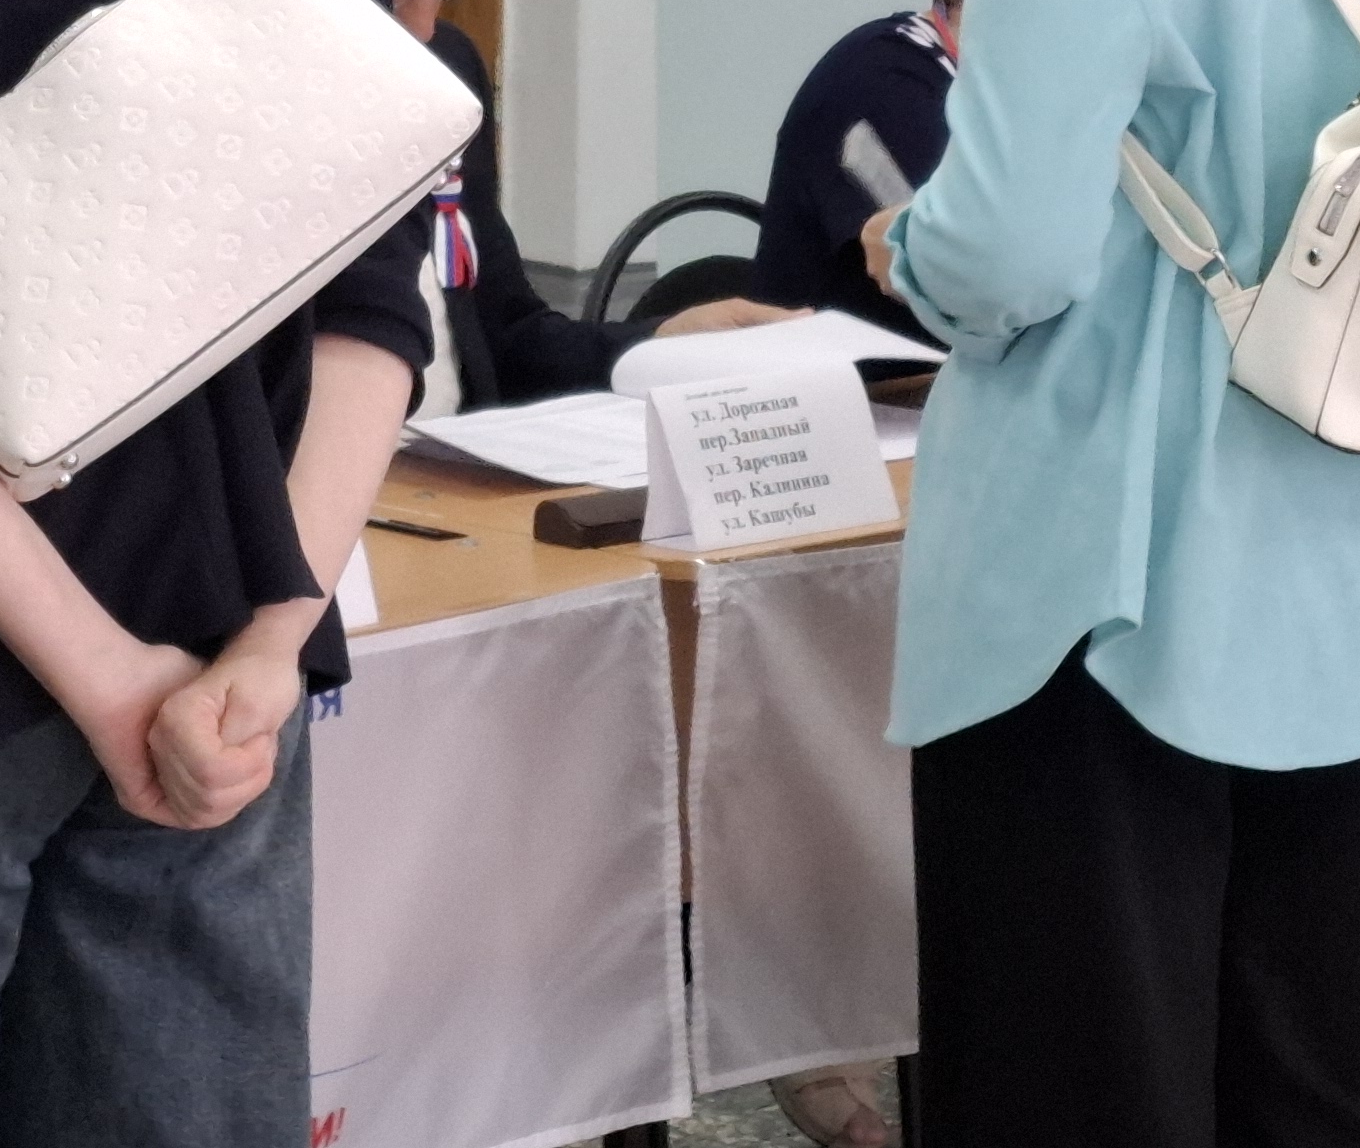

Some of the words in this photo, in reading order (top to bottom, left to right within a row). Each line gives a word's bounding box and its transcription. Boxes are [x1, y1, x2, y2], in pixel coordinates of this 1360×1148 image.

[720, 396, 798, 421] Дорожная
[732, 449, 808, 474] Заречная
[750, 473, 830, 499] Калинина
[748, 502, 816, 527] Кашубы
